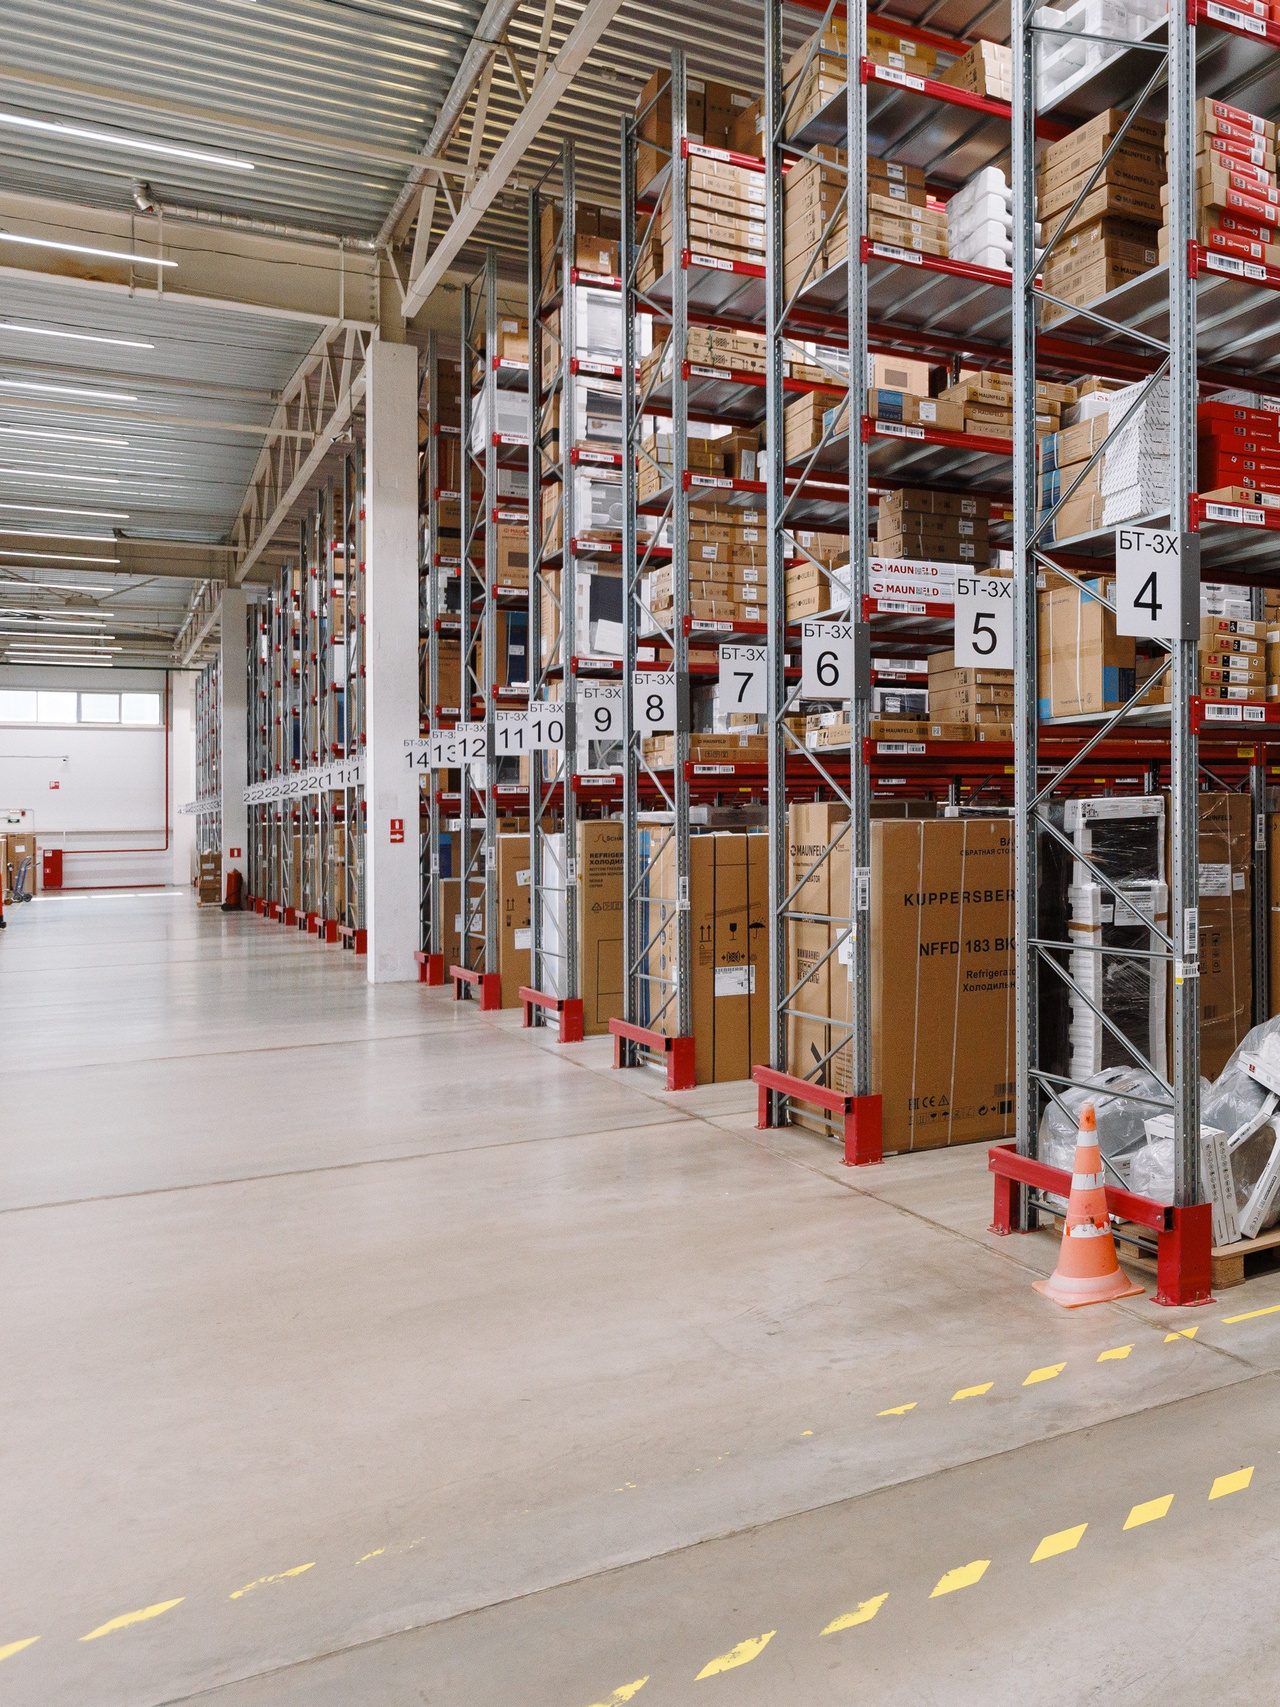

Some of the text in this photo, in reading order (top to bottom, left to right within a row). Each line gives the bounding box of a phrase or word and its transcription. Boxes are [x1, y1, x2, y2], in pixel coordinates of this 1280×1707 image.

[1130, 124, 1157, 137] AUNFELD
[885, 565, 938, 576] MAUND
[886, 585, 939, 596] MAUND
[1133, 571, 1162, 621] 4
[972, 613, 997, 655] 5
[816, 651, 839, 687] 6
[733, 672, 754, 703] 7
[645, 694, 664, 722] 8
[594, 707, 612, 732] 9
[499, 728, 525, 748] 11
[532, 721, 563, 743] 10
[458, 739, 486, 757] 12
[404, 752, 429, 768] 14
[965, 939, 990, 953] 183
